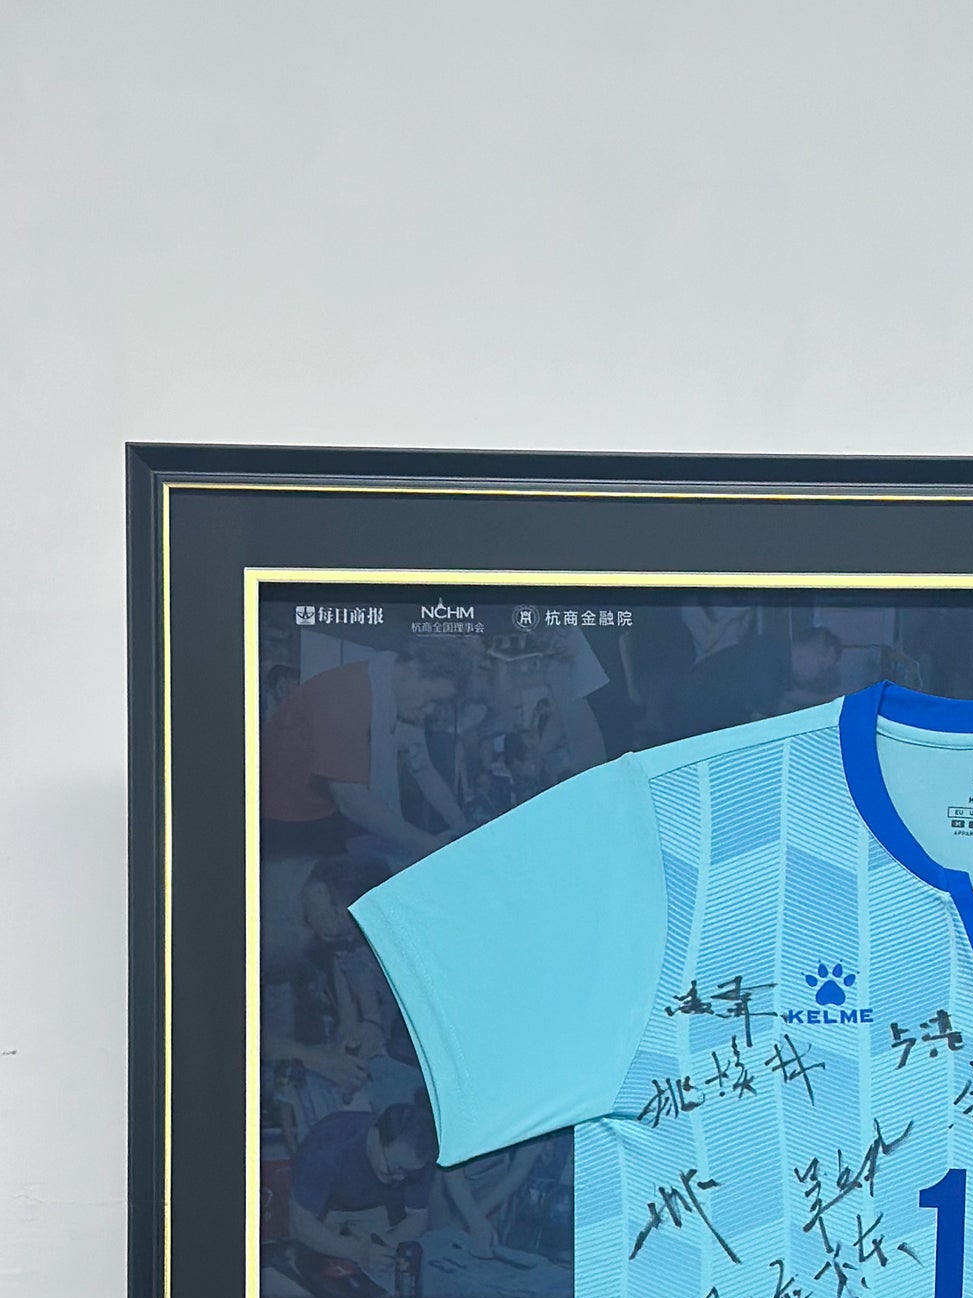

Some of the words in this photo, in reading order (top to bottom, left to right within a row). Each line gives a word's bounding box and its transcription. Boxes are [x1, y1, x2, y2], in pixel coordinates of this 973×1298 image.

[317, 606, 385, 625] 每日商报
[421, 605, 475, 620] NCHM
[544, 609, 633, 627] 杭商金融院
[411, 621, 485, 633] 杭商全国理事会
[787, 1008, 874, 1024] KELME
